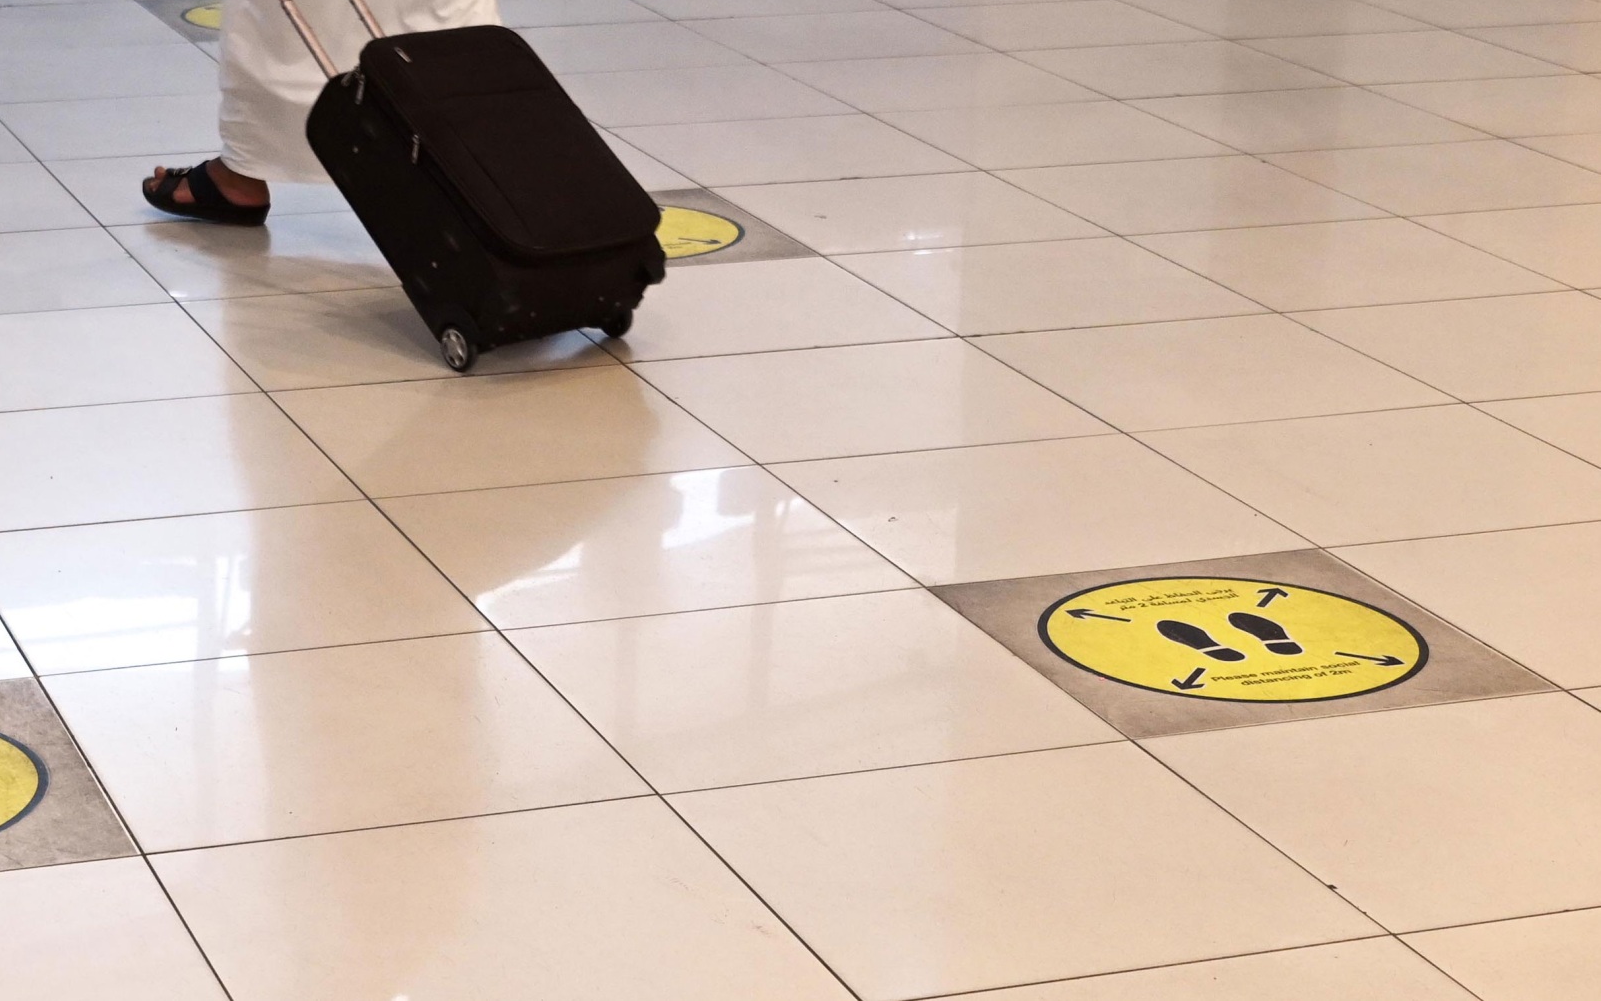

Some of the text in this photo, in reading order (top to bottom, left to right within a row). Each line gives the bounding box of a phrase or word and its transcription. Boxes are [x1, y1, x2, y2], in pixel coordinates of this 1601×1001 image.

[1211, 660, 1361, 682] Please maintain social
[1241, 674, 1313, 686] distancing
